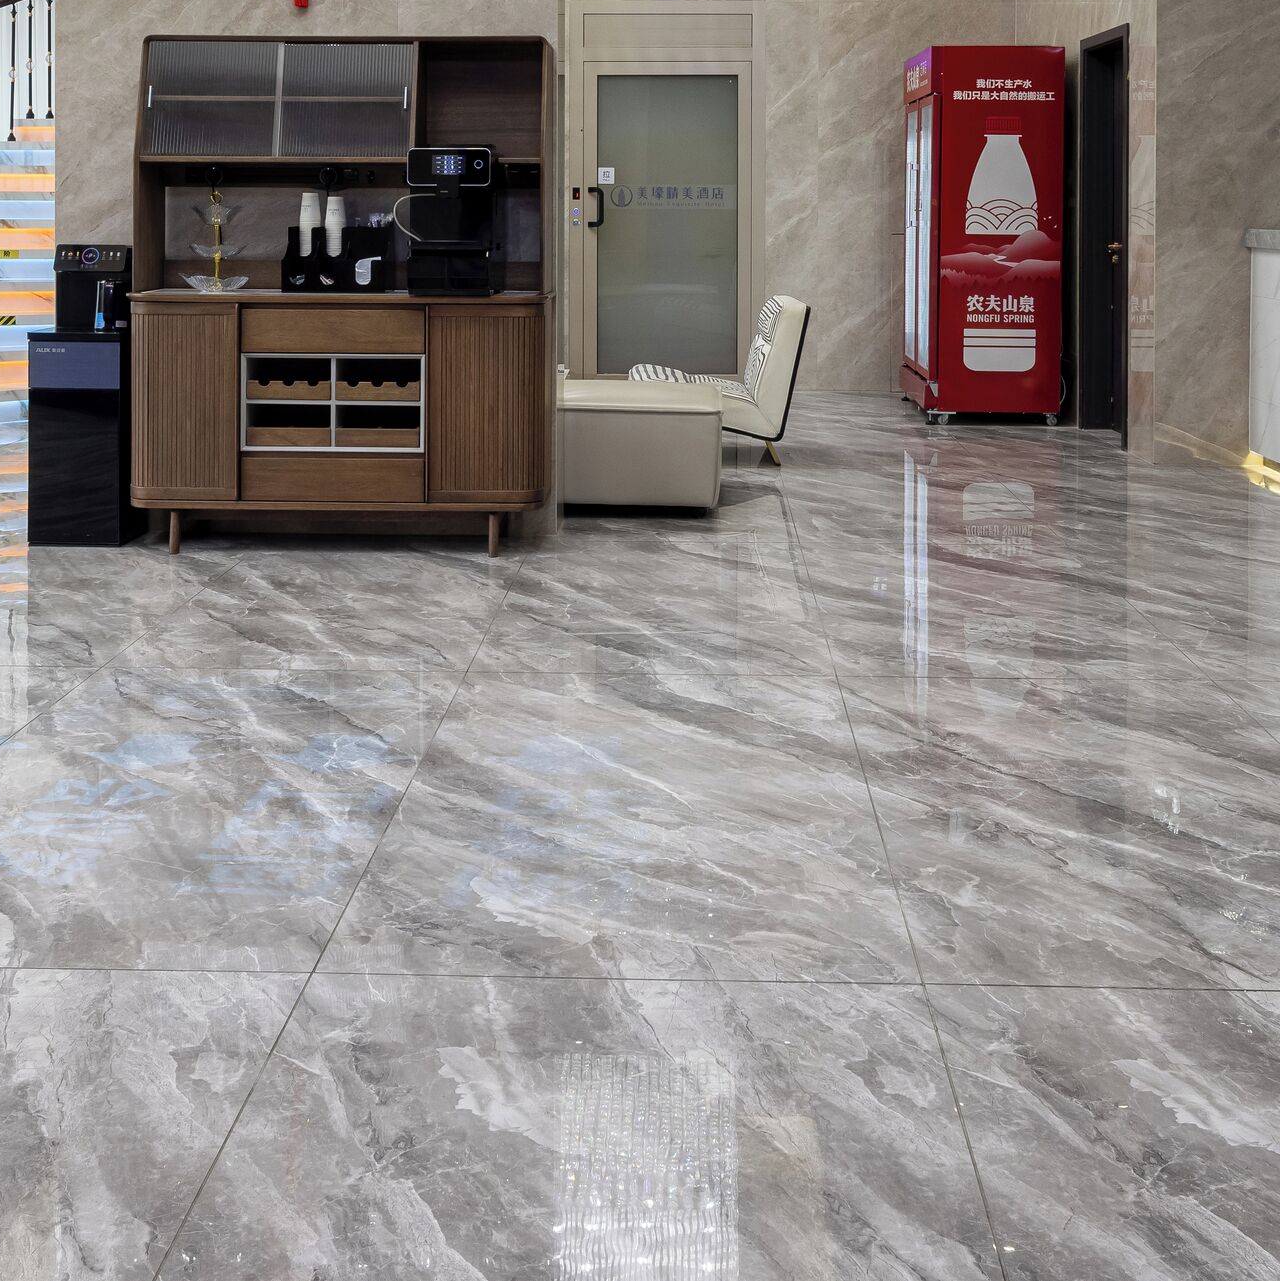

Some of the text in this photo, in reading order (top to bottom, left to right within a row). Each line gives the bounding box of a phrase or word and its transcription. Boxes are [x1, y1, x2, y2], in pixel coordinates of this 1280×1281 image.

[976, 79, 1032, 88] 我们不生产水
[953, 91, 1056, 101] 我们只是大自然的搬运工
[966, 294, 1036, 313] 农夫山泉
[966, 314, 1035, 323] NONGFU SPRING
